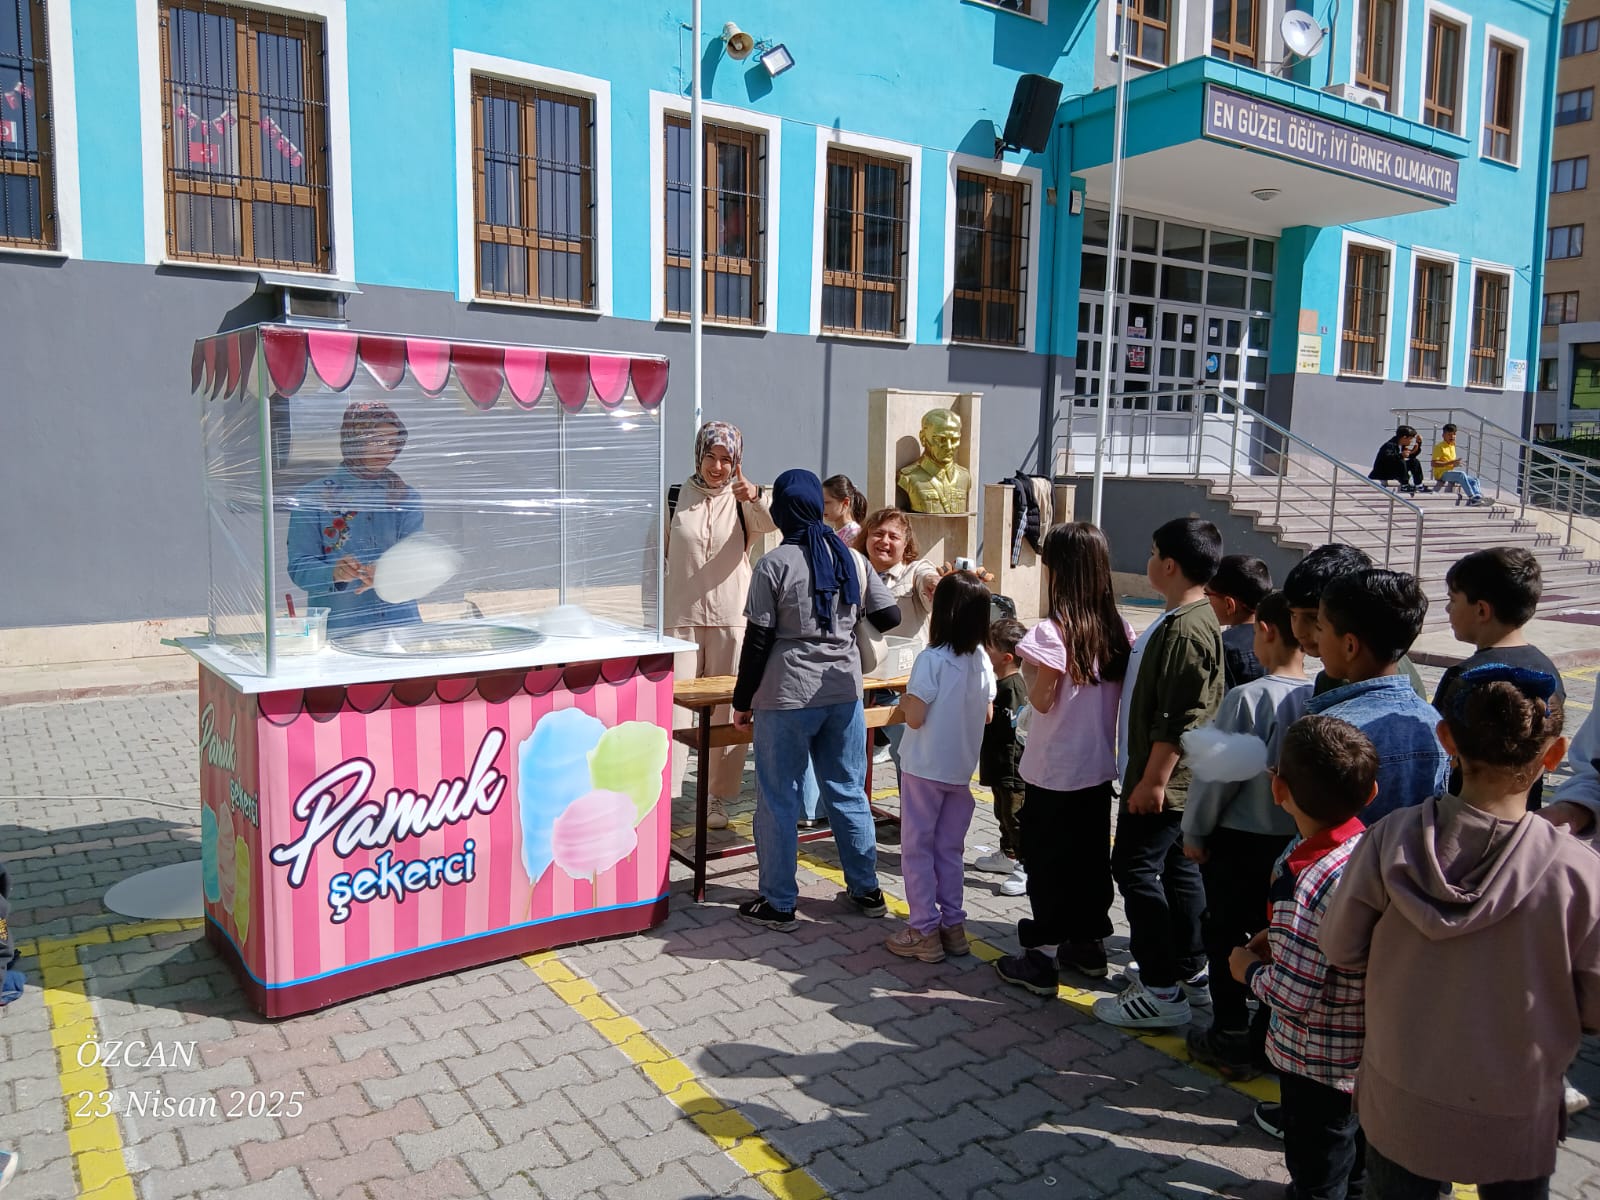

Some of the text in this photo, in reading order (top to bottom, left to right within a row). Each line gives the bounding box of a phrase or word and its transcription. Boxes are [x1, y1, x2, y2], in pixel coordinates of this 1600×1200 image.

[1213, 100, 1454, 194] EN GÜZEL ÖĞÜT; İYİ ÖRNEK OLMAKTIR.
[200, 702, 237, 772] Pamuk
[230, 776, 259, 829] şekerci
[270, 726, 507, 889] Pamuk
[329, 838, 476, 924] şekerci
